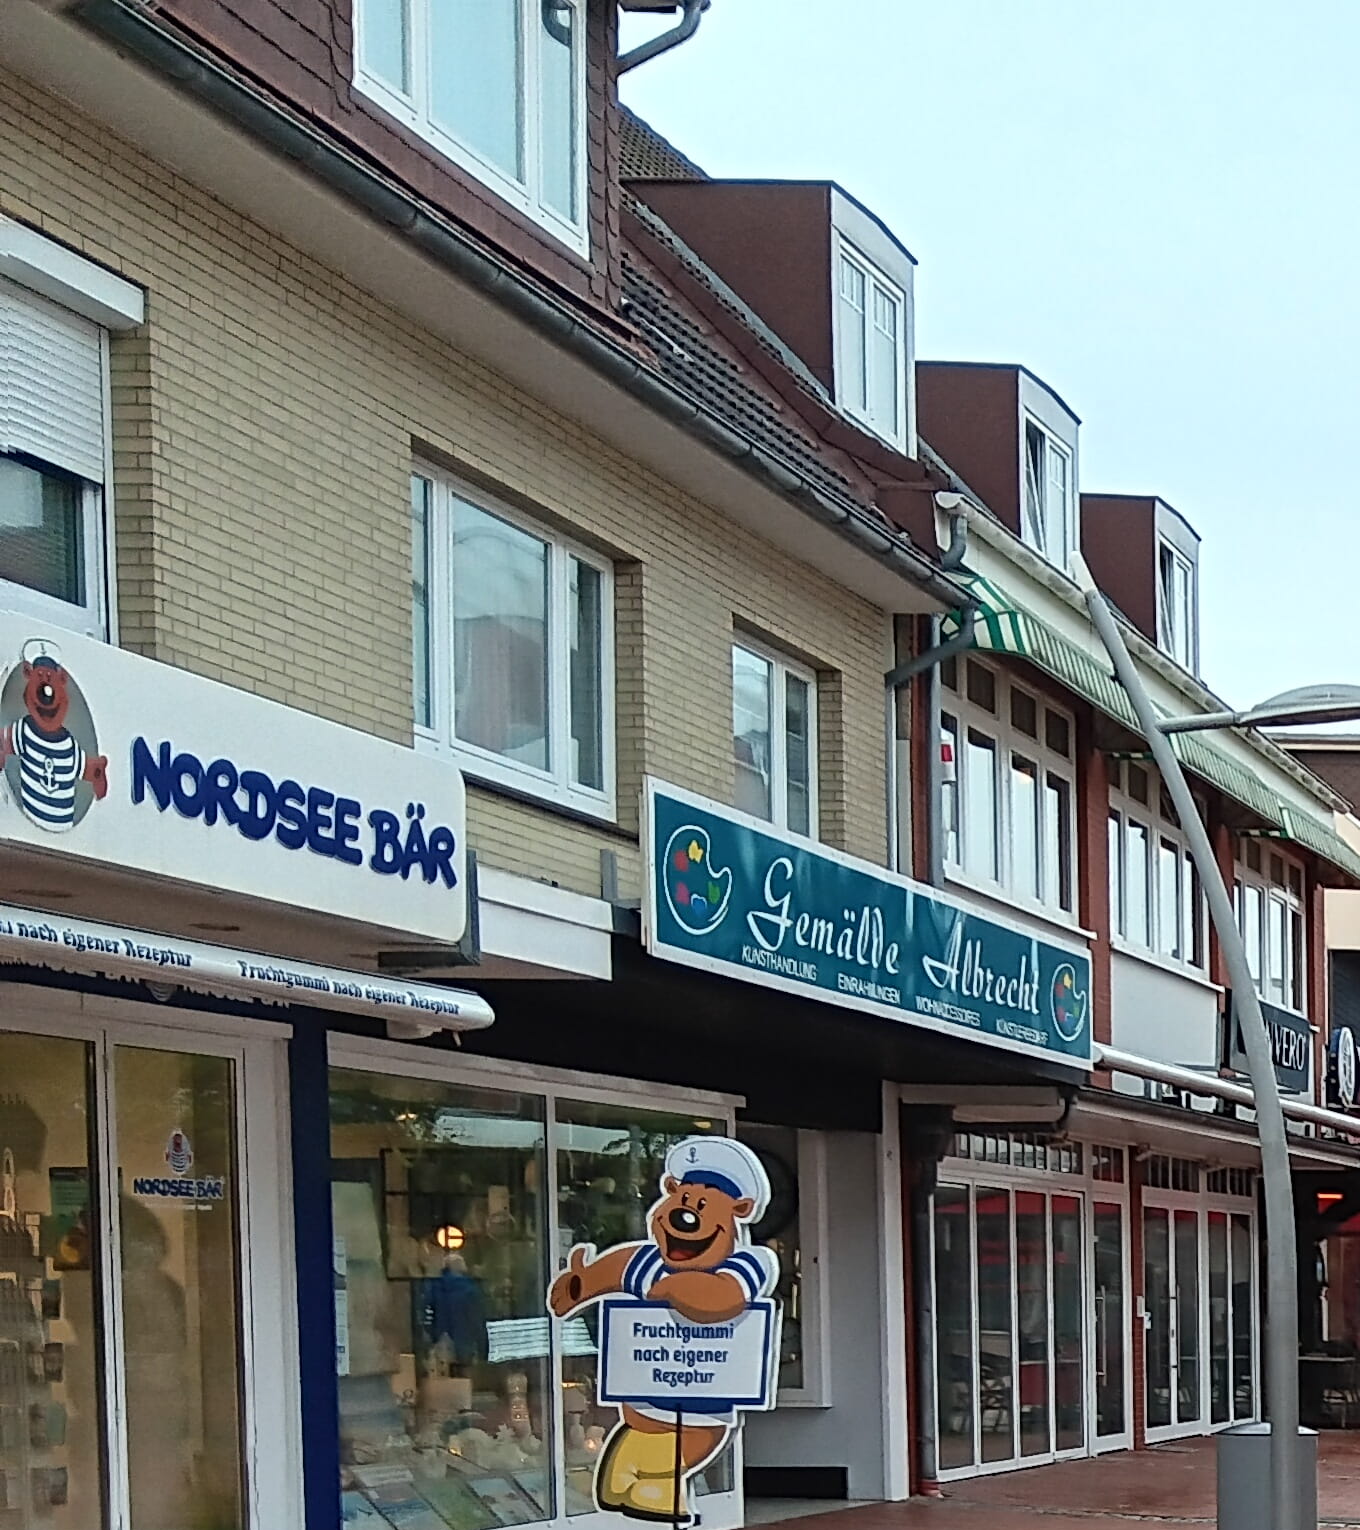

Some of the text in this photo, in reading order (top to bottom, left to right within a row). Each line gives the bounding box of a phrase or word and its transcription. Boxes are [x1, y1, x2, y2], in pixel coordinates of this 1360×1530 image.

[131, 736, 457, 889] NORDSEE BÄR
[17, 922, 58, 943] nach
[63, 928, 120, 953] eigener
[121, 938, 193, 966] Rezeptur
[747, 857, 1040, 1016] Gemälde Albrecht
[742, 945, 818, 982] KUNSTHANDLUNG
[237, 959, 460, 1015] Fruchtgummi nach eigener Rezeptur
[133, 1175, 223, 1198] NORDSEE BÄR
[633, 1321, 735, 1344] Fruchtgummi
[633, 1345, 729, 1367] nach eigener
[652, 1367, 716, 1388] Rezeptur
